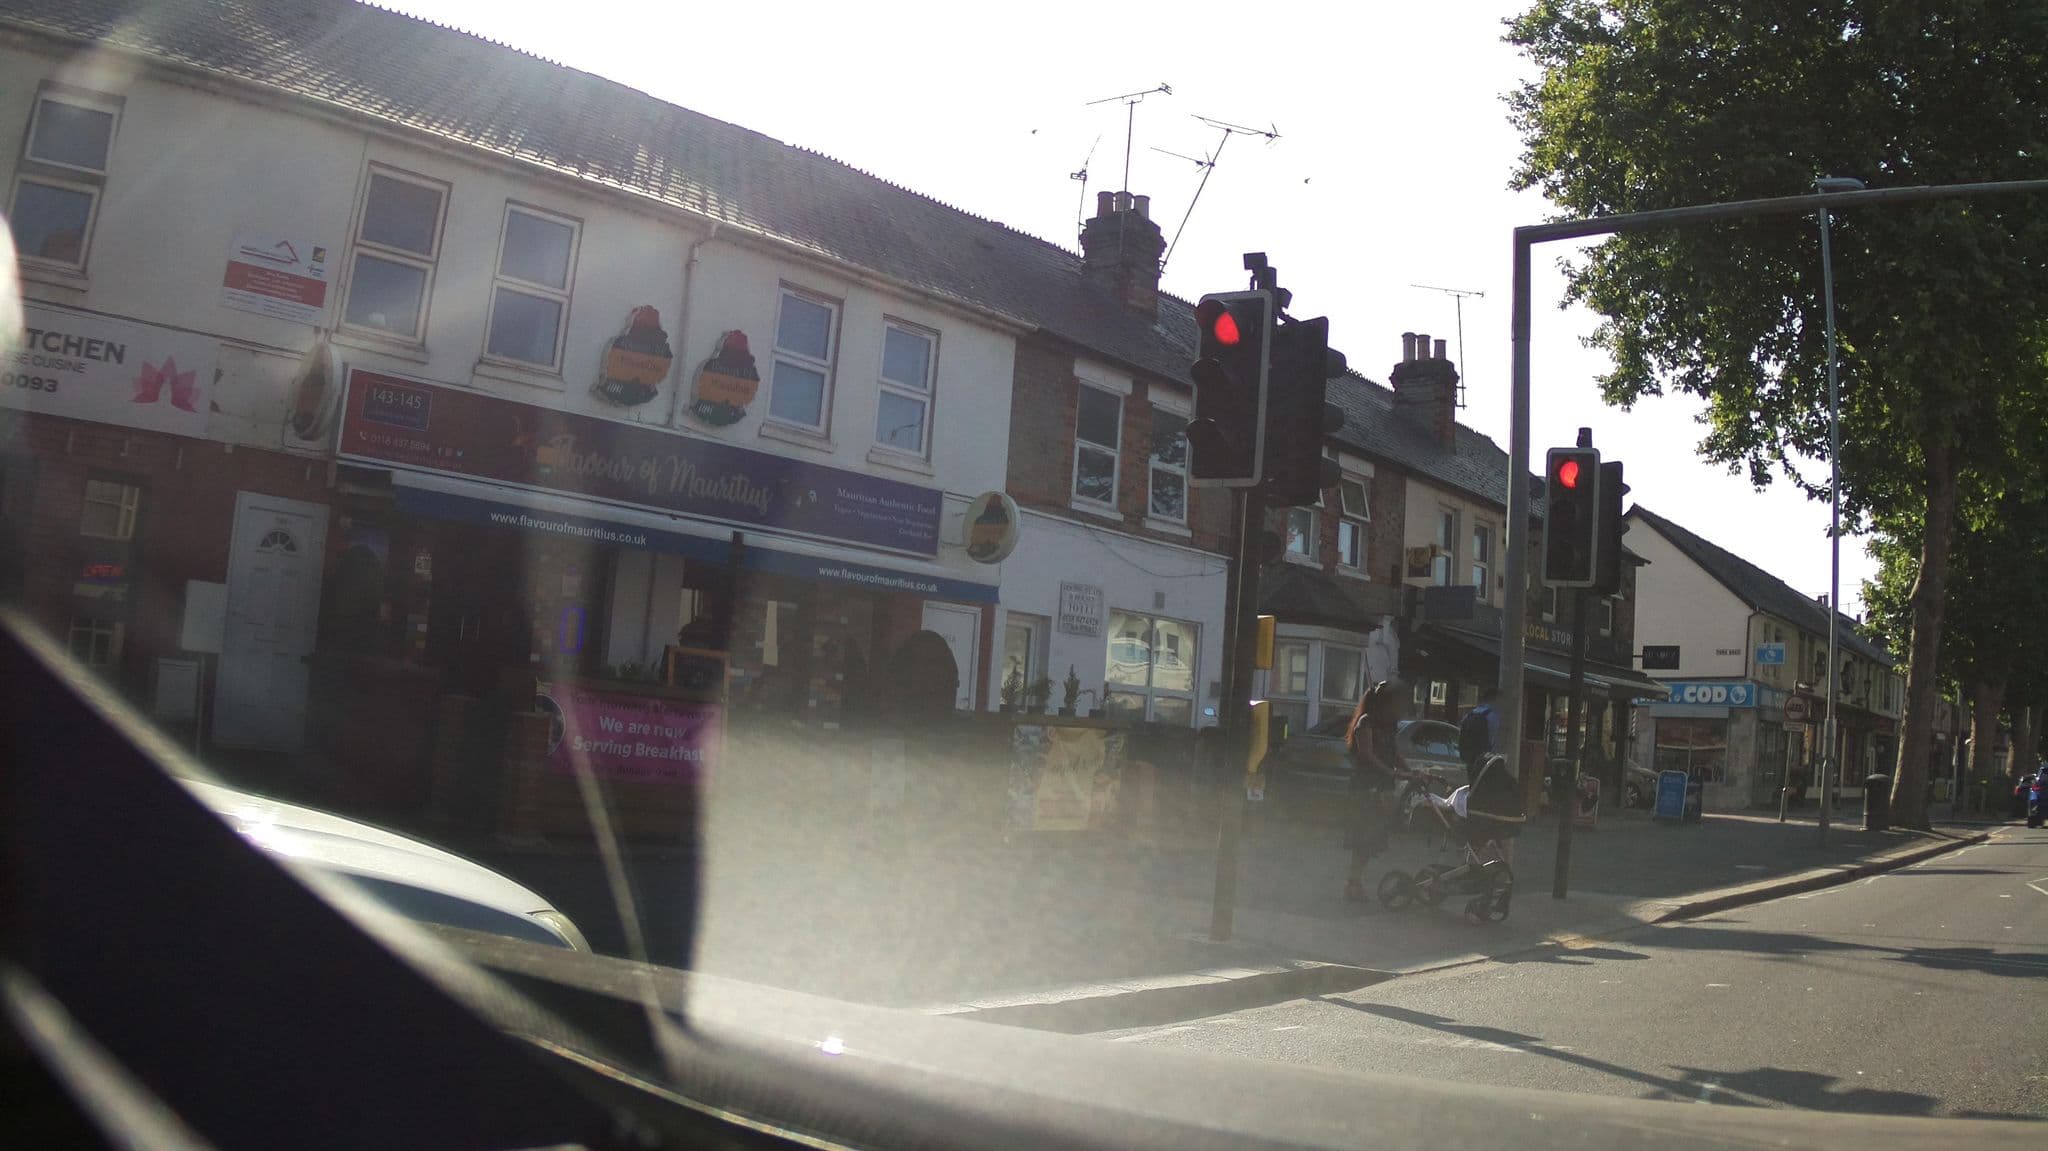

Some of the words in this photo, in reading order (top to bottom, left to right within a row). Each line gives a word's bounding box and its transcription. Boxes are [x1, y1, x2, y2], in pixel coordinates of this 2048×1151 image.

[26, 328, 126, 365] TCHEN
[639, 459, 662, 495] of
[665, 456, 772, 514] Mauritius
[490, 511, 647, 545] www.flavourofmauritius.co.uk
[1552, 630, 1574, 646] STOR
[1683, 686, 1727, 703] COD
[599, 716, 623, 733] We
[628, 722, 650, 736] are
[654, 725, 687, 738] now
[573, 735, 632, 757] Serving
[635, 742, 704, 761] Breakfast
